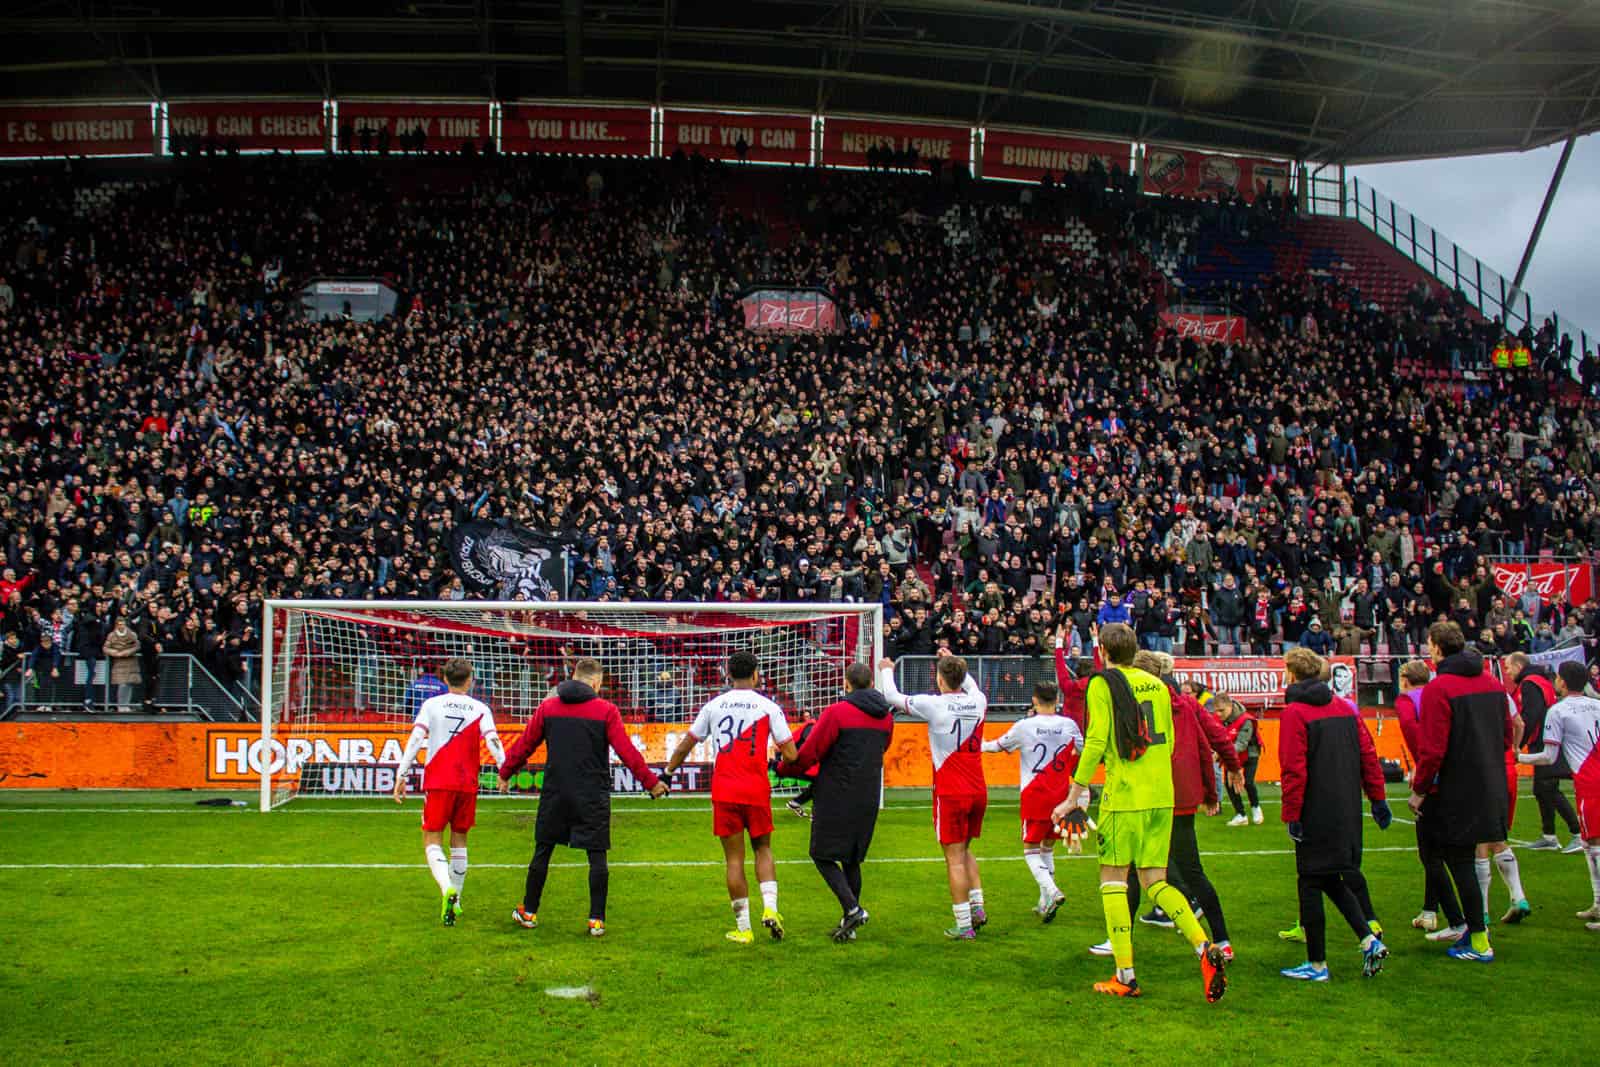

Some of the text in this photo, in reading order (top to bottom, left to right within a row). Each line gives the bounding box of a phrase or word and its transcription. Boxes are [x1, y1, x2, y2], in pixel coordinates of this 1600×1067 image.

[8, 120, 135, 142] F.C. UTRECHT
[216, 115, 253, 136] CAN
[260, 115, 321, 137] CHECK
[437, 117, 480, 138] TIME
[527, 120, 563, 140] YOU
[677, 124, 796, 150] BUT YOU CAN
[1209, 671, 1278, 692] TOMMASO
[444, 714, 466, 747] 7
[716, 714, 758, 756] 34
[1032, 743, 1067, 774] 26
